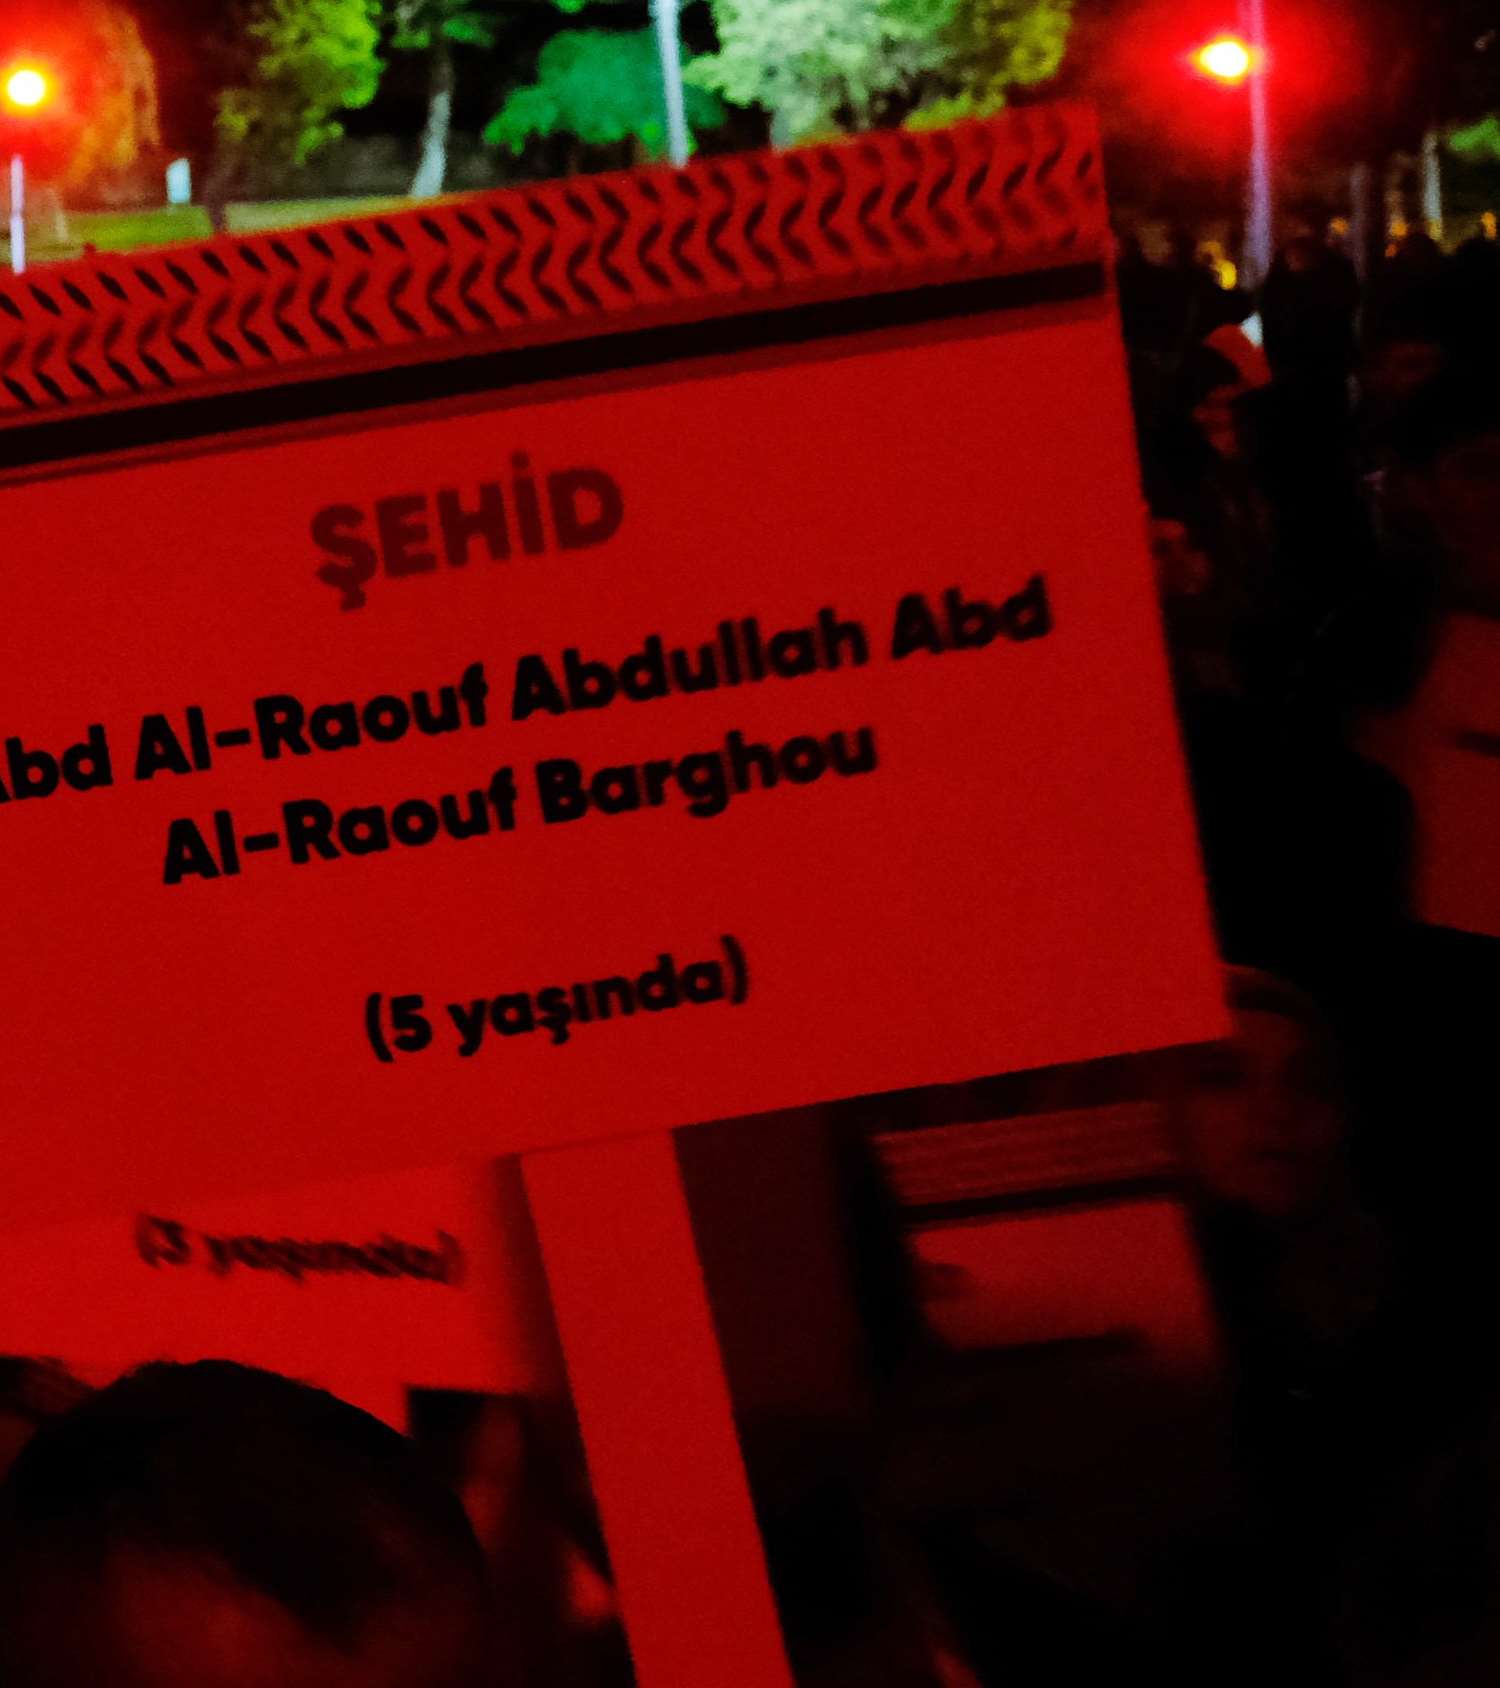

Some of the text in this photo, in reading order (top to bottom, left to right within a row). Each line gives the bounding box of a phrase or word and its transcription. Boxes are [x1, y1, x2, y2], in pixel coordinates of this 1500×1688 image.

[311, 451, 625, 612] ŞEHİD
[133, 661, 490, 782] Al-Raouf
[511, 606, 871, 721] Abdullah
[889, 572, 1056, 661] Abd
[162, 726, 881, 886] Al-Raouf Barghou
[363, 933, 752, 1064] (5 yaşında)
